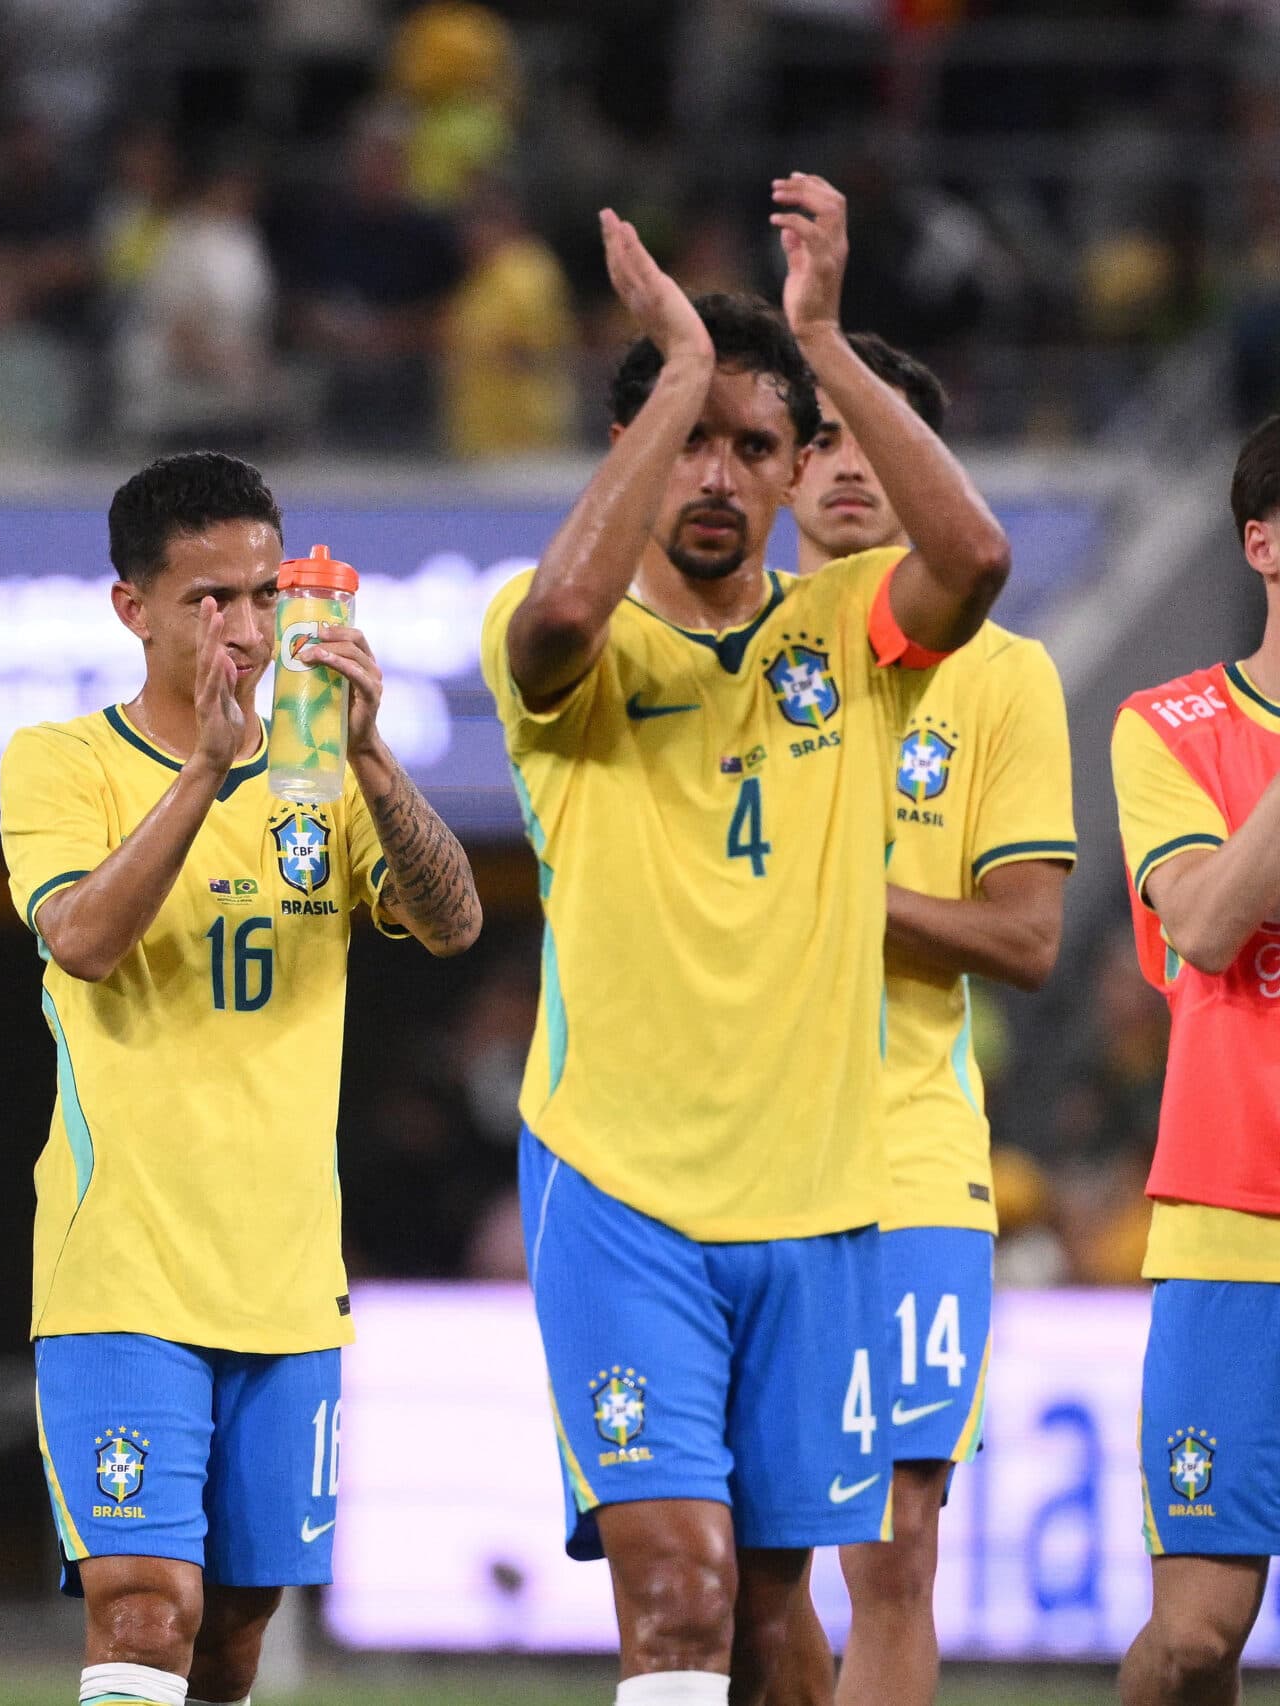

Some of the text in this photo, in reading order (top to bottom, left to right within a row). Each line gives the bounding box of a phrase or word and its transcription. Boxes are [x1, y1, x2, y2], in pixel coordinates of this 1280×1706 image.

[726, 777, 771, 877] 4
[293, 846, 313, 856] CBF
[281, 900, 339, 915] BRASIL
[206, 915, 274, 1012] 16
[895, 1292, 966, 1387] 14
[842, 1348, 877, 1454] 4
[111, 1464, 130, 1472] CBF
[93, 1505, 146, 1519] BRASIL
[1168, 1503, 1216, 1517] BRASIL
